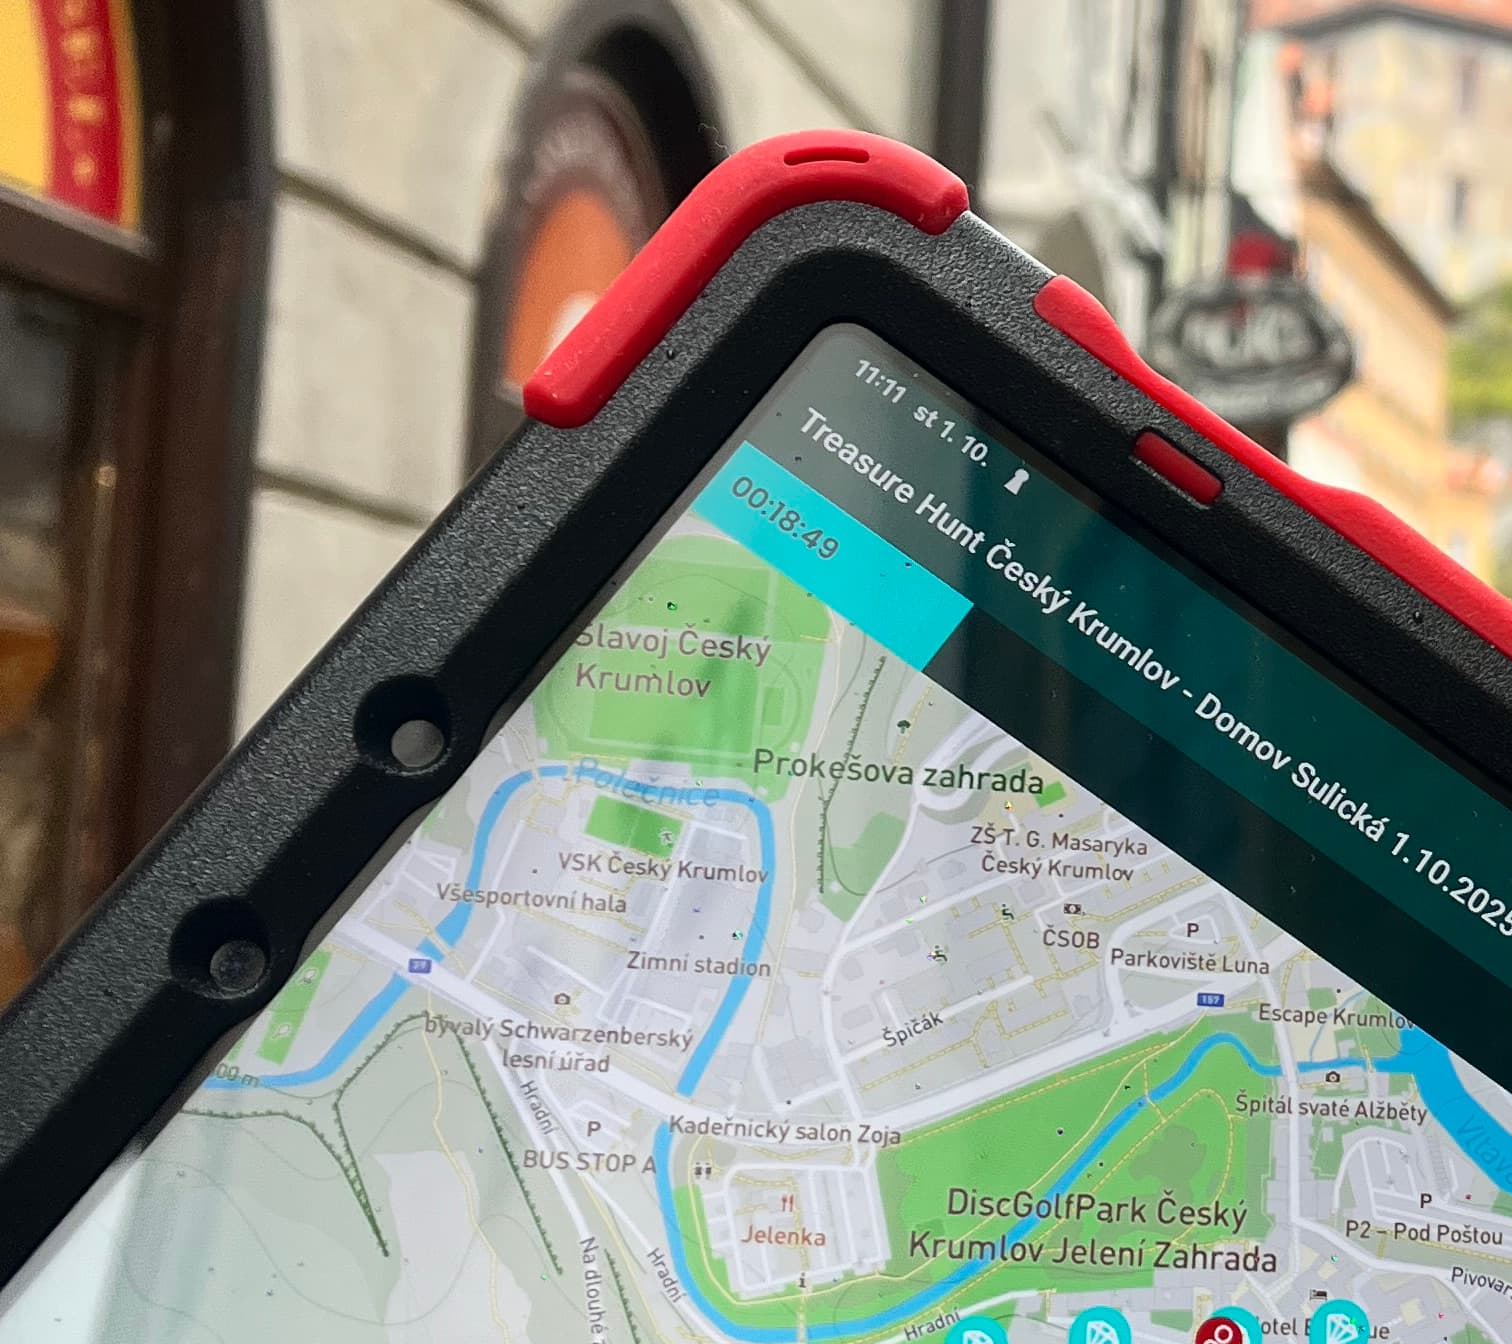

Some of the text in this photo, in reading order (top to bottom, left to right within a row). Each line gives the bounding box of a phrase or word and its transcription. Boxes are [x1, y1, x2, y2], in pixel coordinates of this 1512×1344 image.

[855, 359, 990, 466] 11:11 st 10.
[732, 476, 840, 560] 00:18:49
[800, 408, 917, 505] Treasure
[916, 492, 986, 555] Hunt
[986, 538, 1070, 615] Český
[1068, 601, 1181, 689] Krumlov
[1195, 692, 1292, 772] Domov
[1290, 762, 1390, 842] Sulická
[679, 623, 772, 667] Český
[576, 663, 712, 698] Krumlov
[754, 748, 1044, 795] Prokešova zahrada
[971, 822, 1148, 860] ZŠ Masaryka
[558, 849, 768, 884] VSK Český Krumlov
[982, 854, 1135, 882] Český Krumlov
[437, 882, 627, 913] Všesportovní hala
[1043, 924, 1100, 951] ČSOB
[627, 950, 771, 977] Zimní stadion
[1111, 948, 1270, 976] Parkoviště Luna
[425, 1015, 693, 1053] bývalý Schwarzenberský
[882, 1009, 944, 1049] Špičák
[1258, 1004, 1415, 1031] Escape Krumlov
[502, 1050, 554, 1071] lesní
[1236, 1092, 1428, 1126] Špitál svaté Alžběty
[669, 1114, 901, 1146] Kadeřnický salon Zoja
[524, 1150, 636, 1173] BUS STOP
[947, 1188, 1248, 1233] DiscGolfPark Český
[741, 1224, 827, 1247] Jelenka
[1393, 1222, 1504, 1246] Pod Poštou
[909, 1231, 1277, 1274] Krumlov Jelení Zahrada
[646, 1247, 684, 1304] Hradní
[904, 1307, 961, 1342] Hradní
